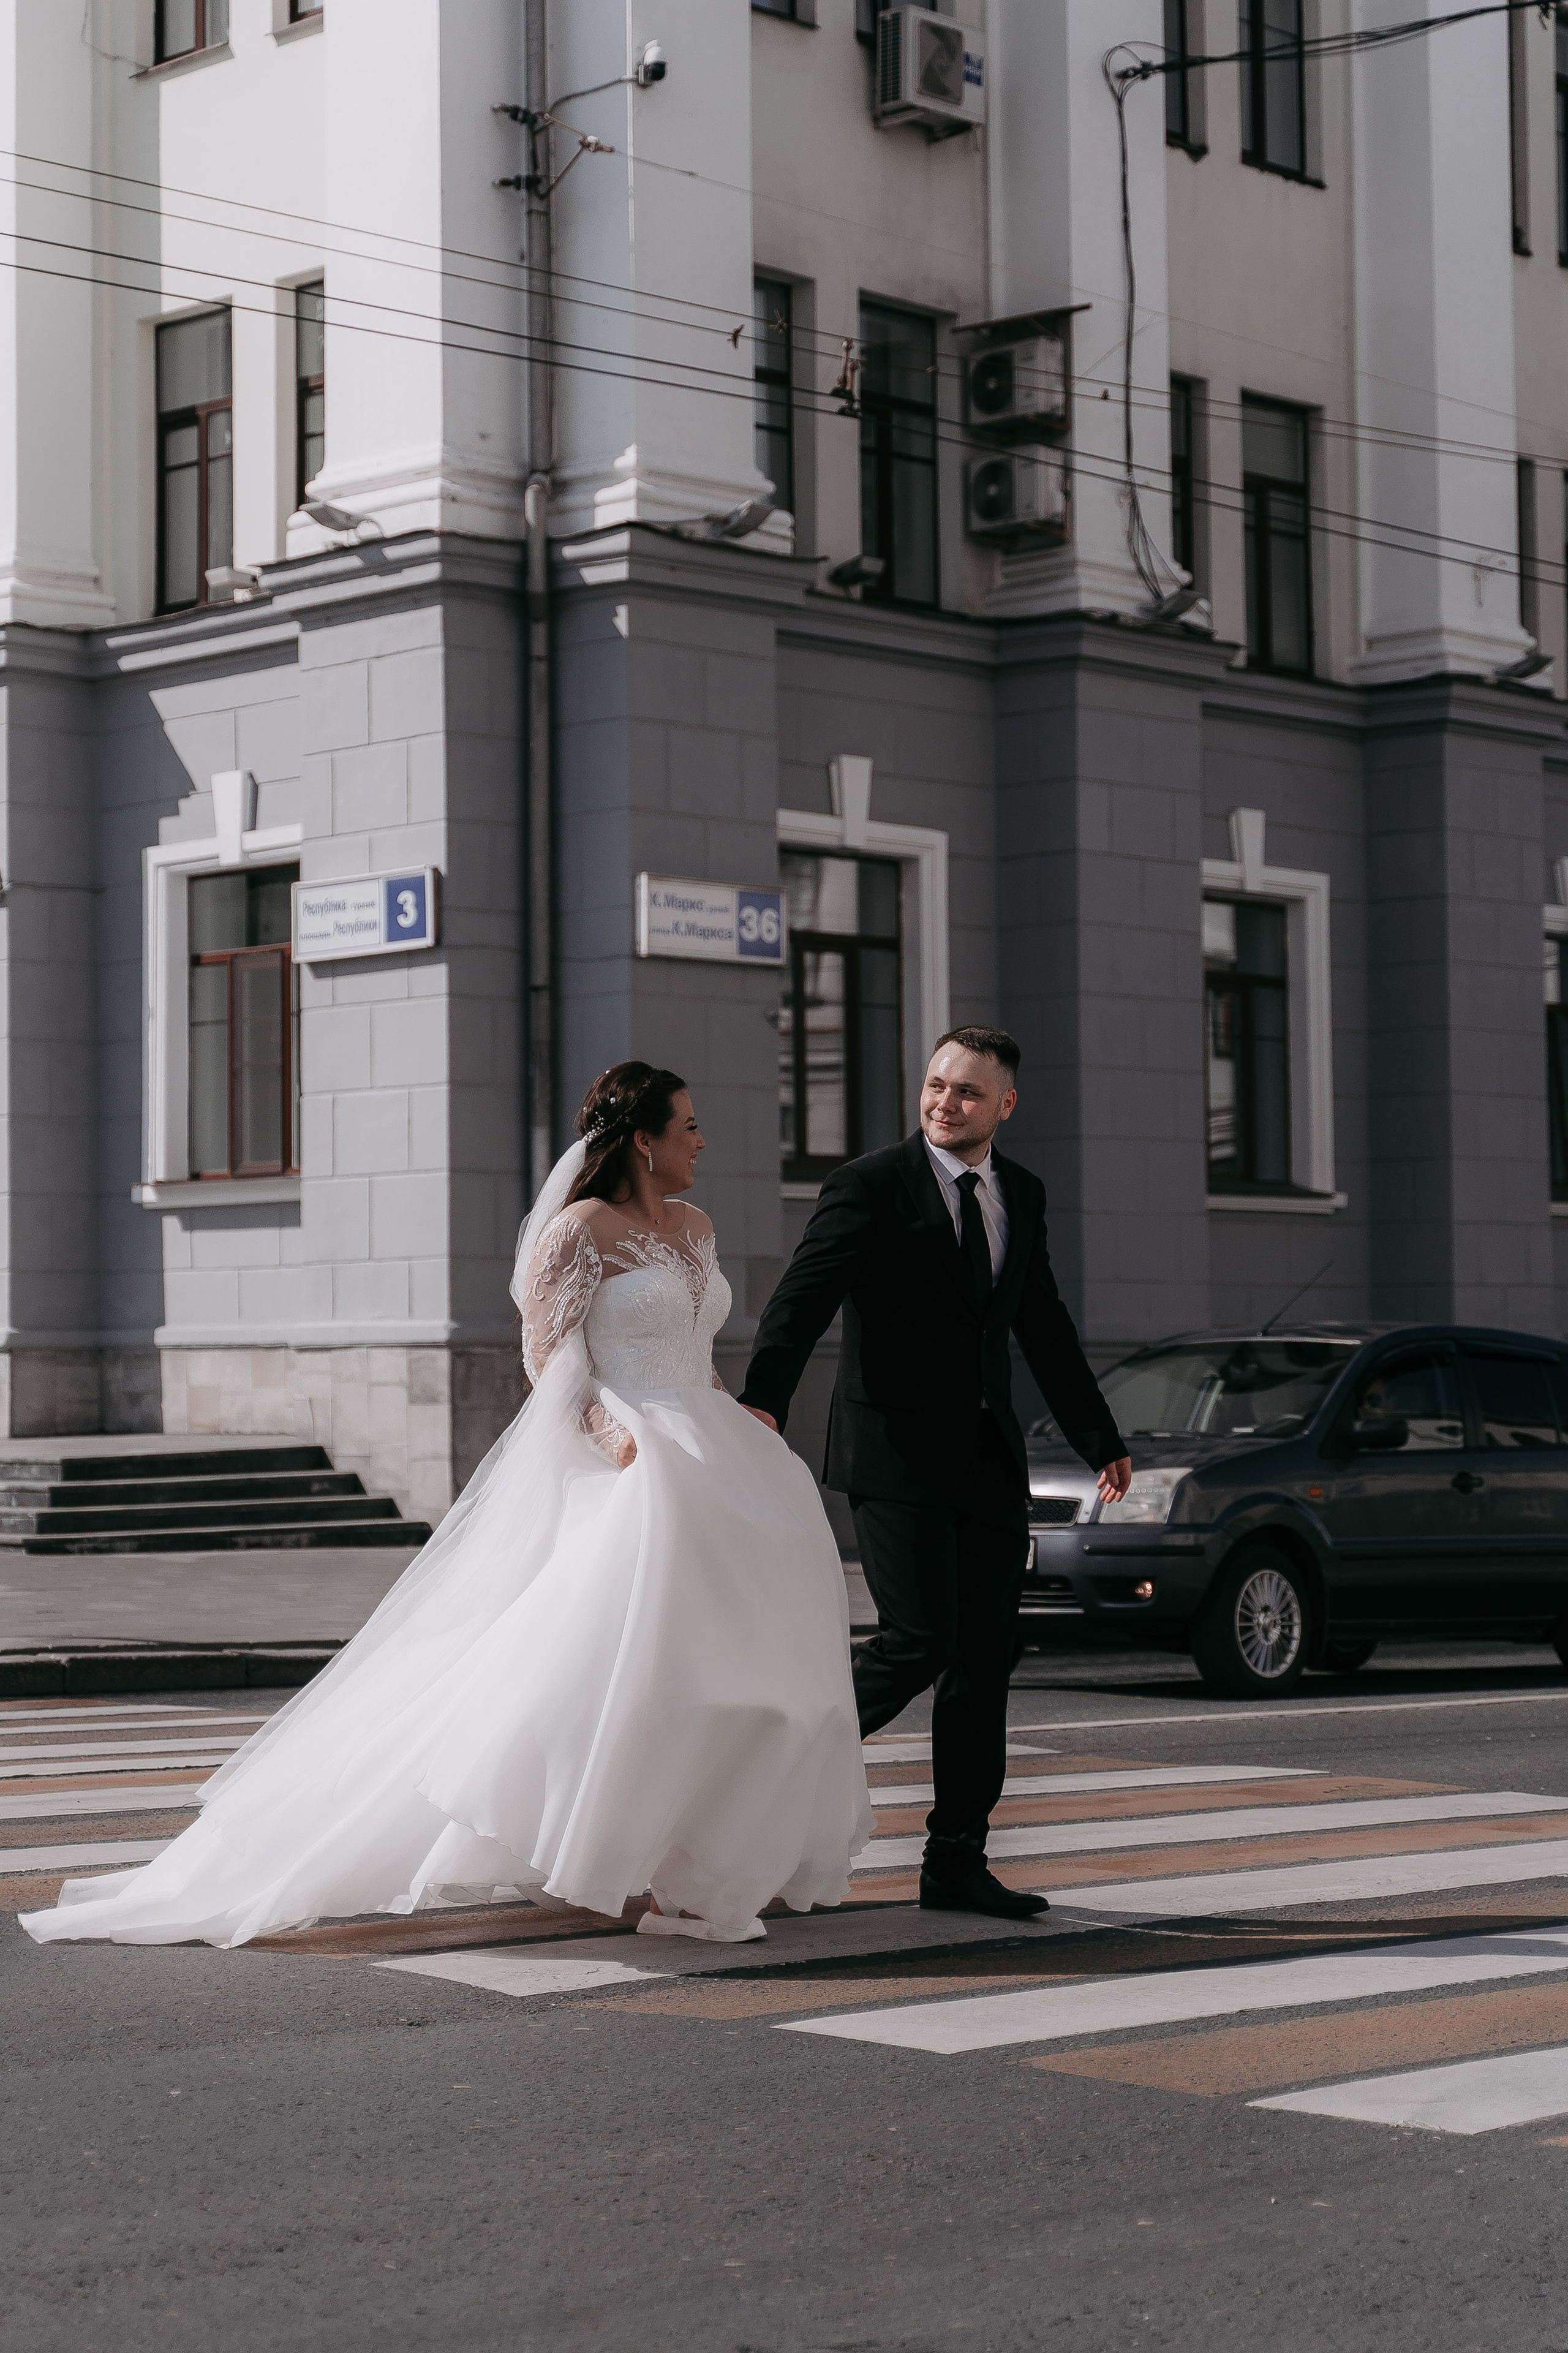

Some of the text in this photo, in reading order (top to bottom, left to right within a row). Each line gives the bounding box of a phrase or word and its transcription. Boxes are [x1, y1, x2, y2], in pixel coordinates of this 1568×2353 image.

[302, 897, 347, 916] Республика
[396, 889, 418, 928] 3
[333, 916, 377, 938] Республики
[739, 905, 778, 944] 36
